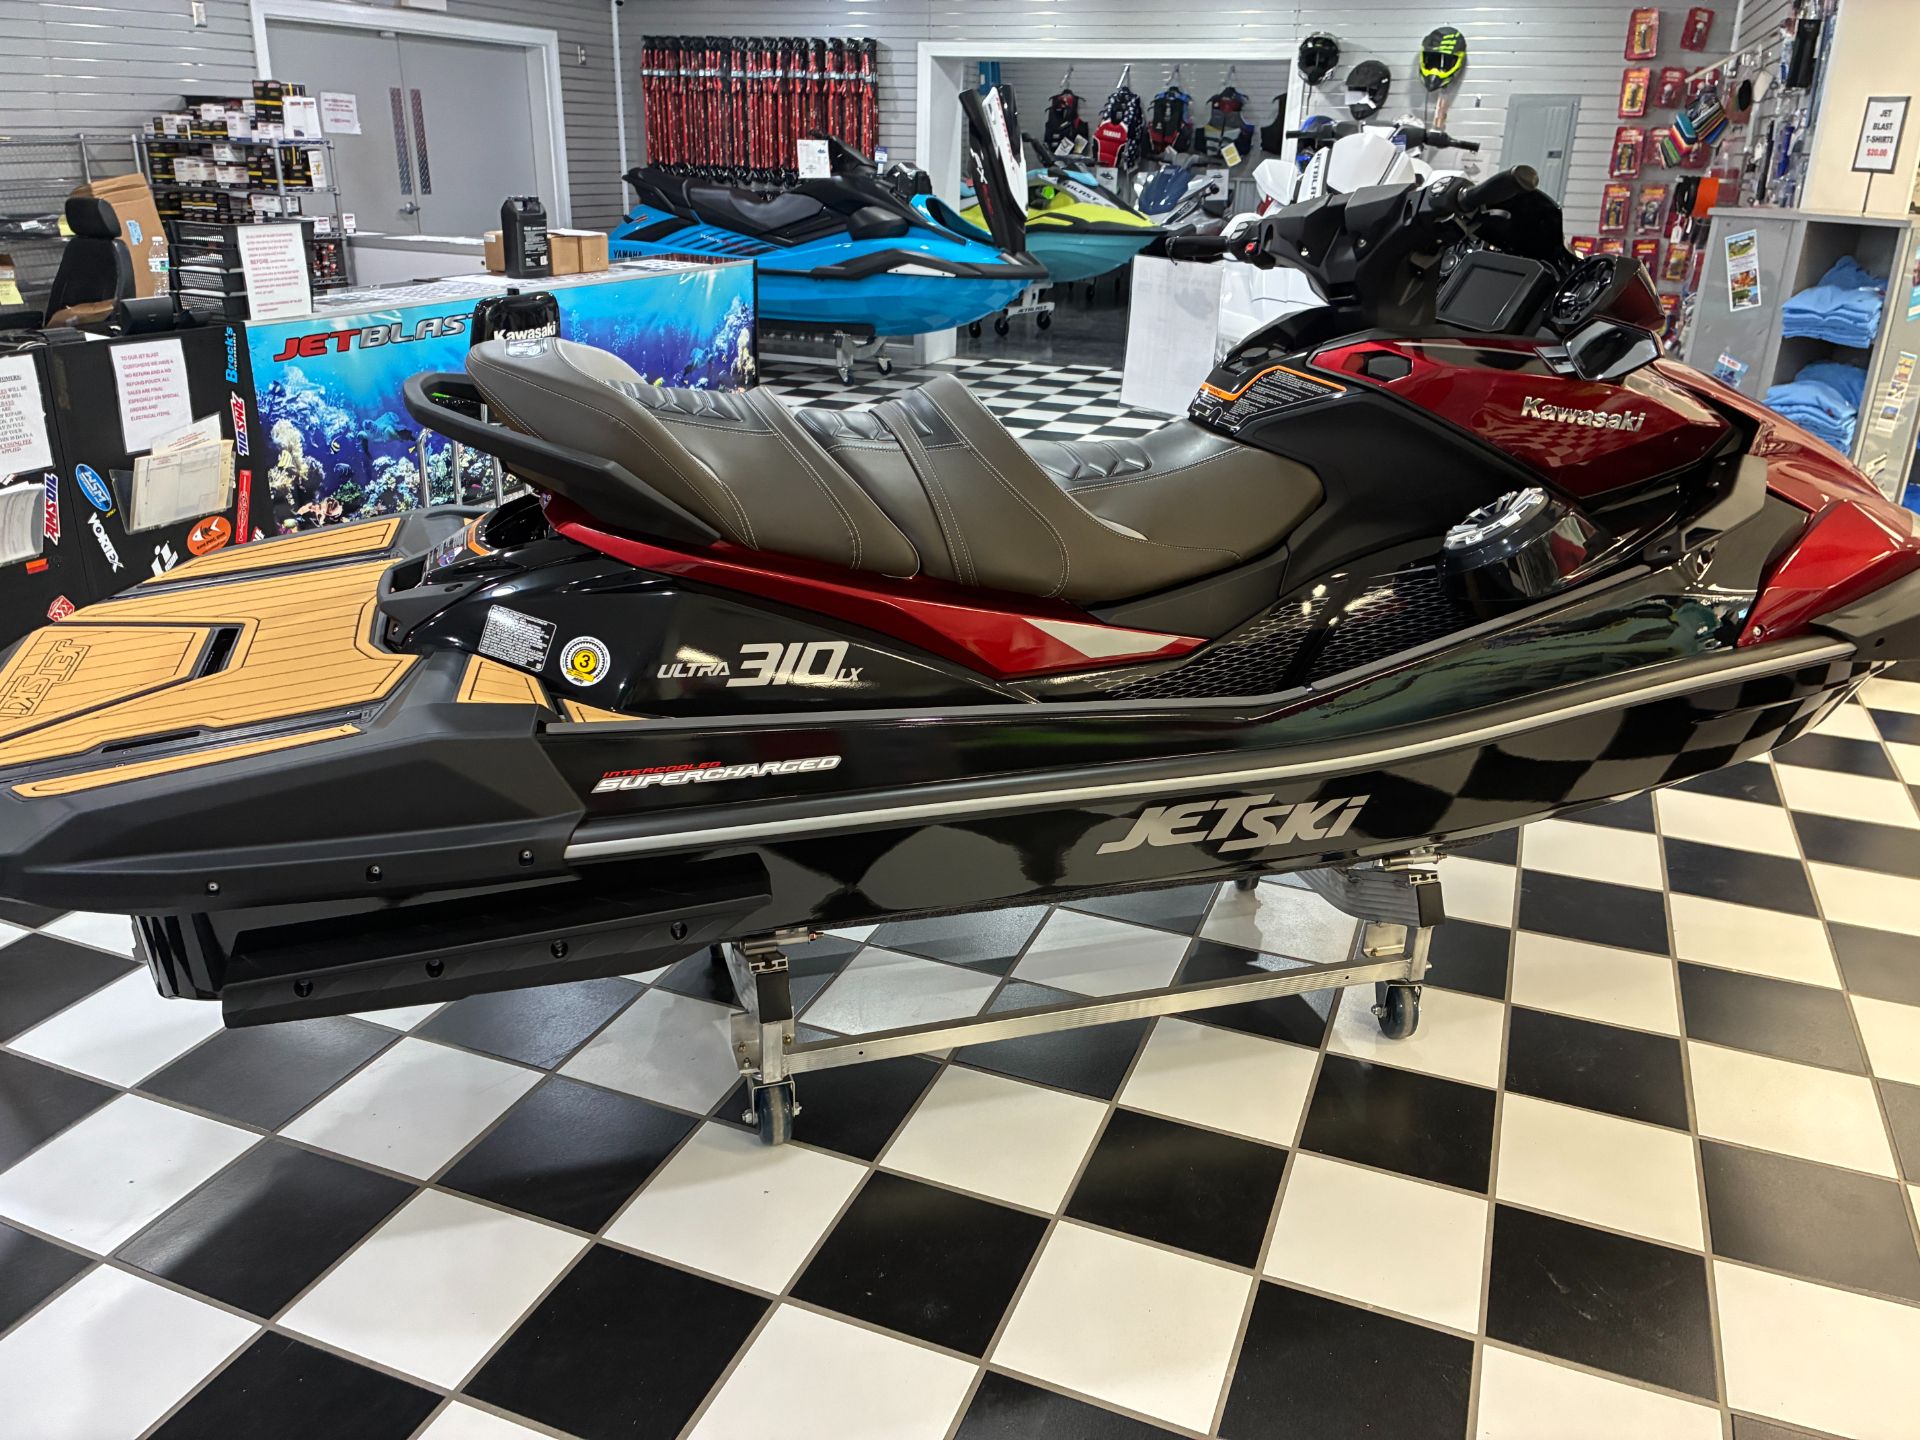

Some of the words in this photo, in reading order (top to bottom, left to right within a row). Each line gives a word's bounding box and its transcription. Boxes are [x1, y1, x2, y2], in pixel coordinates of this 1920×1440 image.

[1880, 109, 1892, 117] JET
[614, 249, 642, 258] YAMAHA
[273, 313, 476, 362] JETBLAS
[493, 321, 556, 341] Kawasaki
[225, 326, 238, 383] Brock's
[230, 391, 249, 456] AMSOIL
[1520, 396, 1647, 432] Kawasaki
[82, 471, 108, 505] WSM
[44, 473, 61, 546] AMSOIL
[88, 512, 124, 573] VORTEX
[579, 653, 591, 669] 3
[657, 661, 731, 679] ULTRA
[725, 641, 850, 688] 310
[837, 667, 864, 682] LX
[591, 756, 842, 794] SUPERCHARGED
[603, 761, 721, 778] INTERCOOLED
